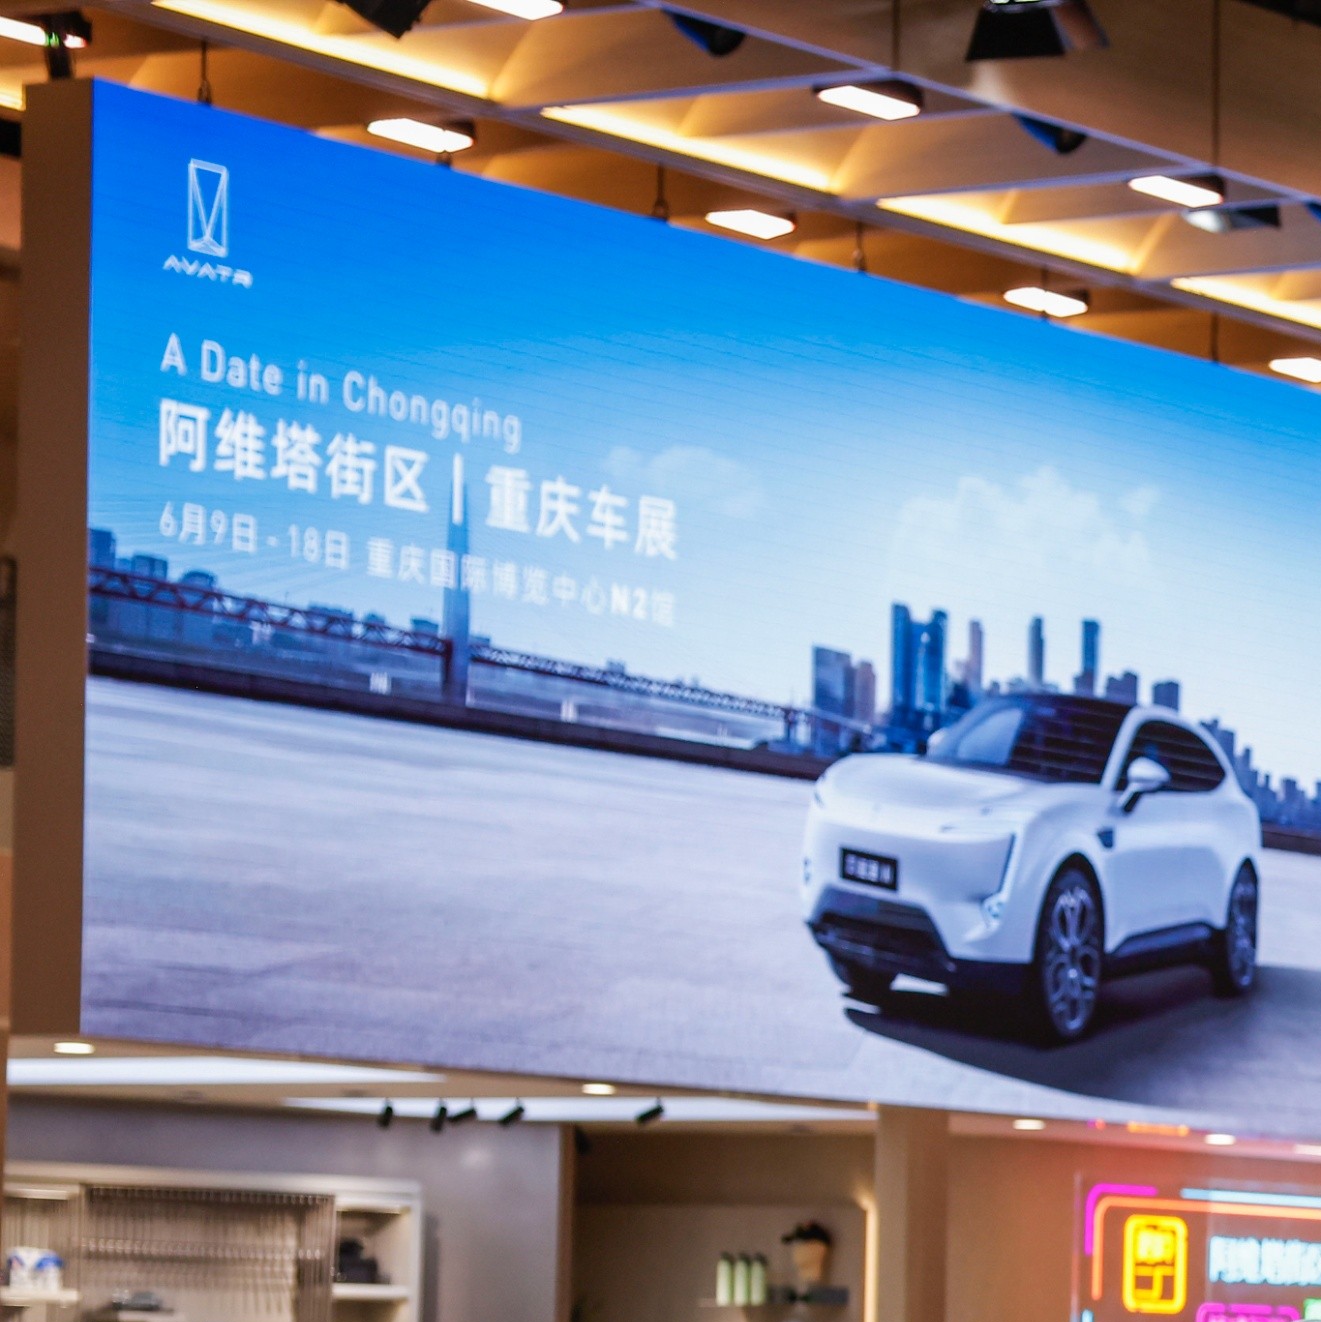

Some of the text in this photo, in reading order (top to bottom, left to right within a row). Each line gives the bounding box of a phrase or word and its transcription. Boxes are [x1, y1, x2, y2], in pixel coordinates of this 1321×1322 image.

[162, 255, 253, 289] AVATR
[160, 332, 522, 455] A Date in Chongqing
[159, 398, 677, 560] 阿维塔街区 重庆车展
